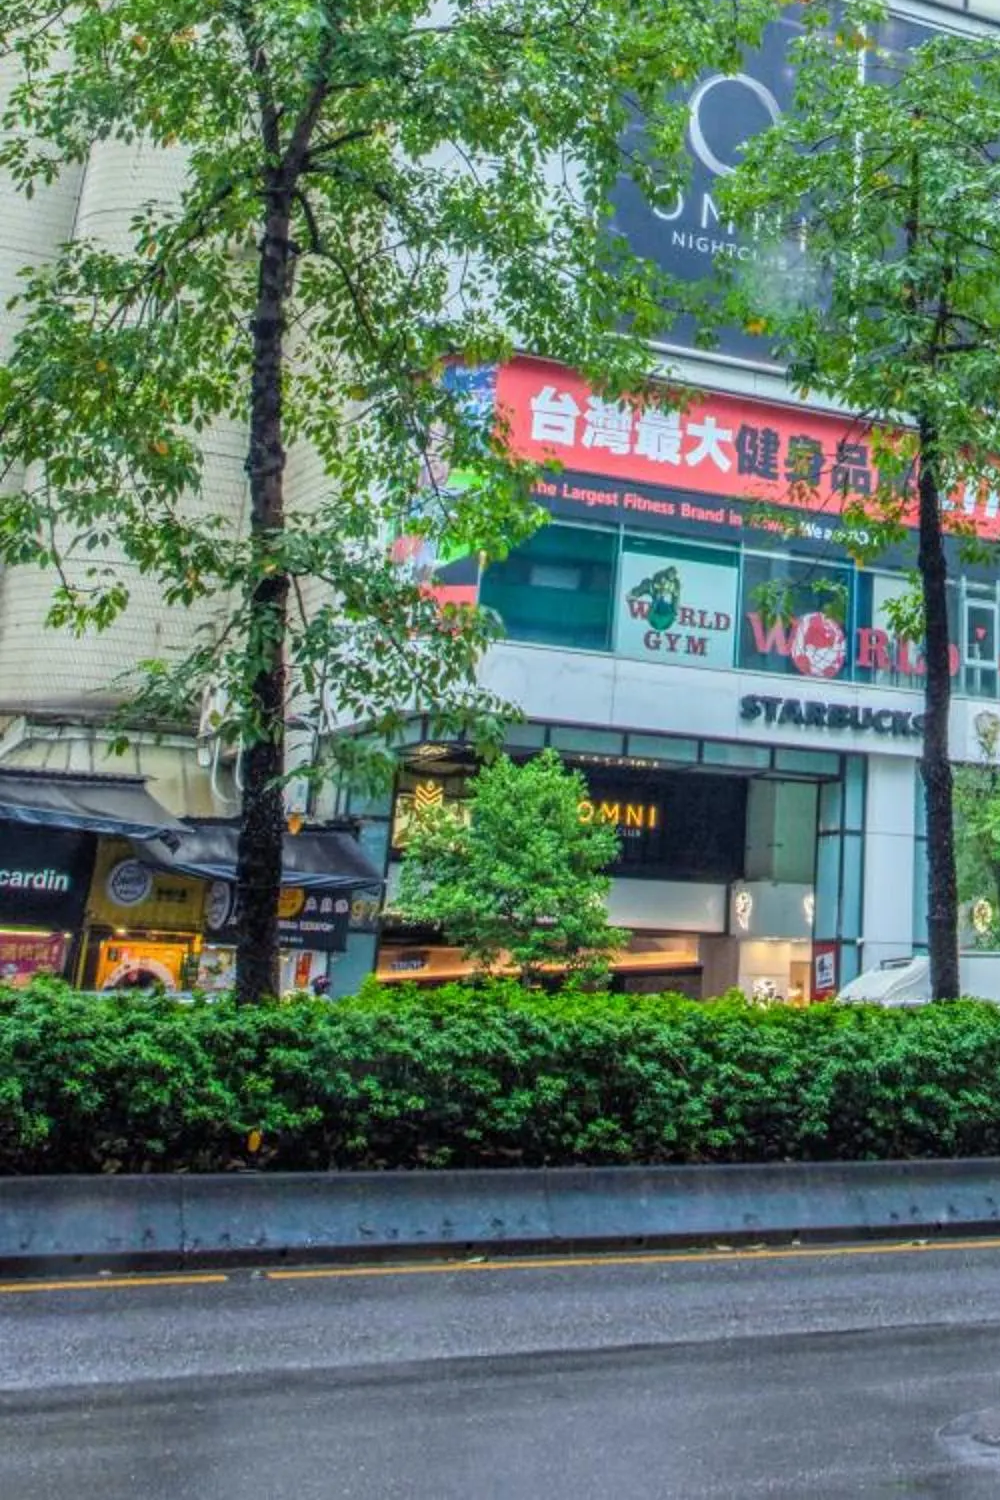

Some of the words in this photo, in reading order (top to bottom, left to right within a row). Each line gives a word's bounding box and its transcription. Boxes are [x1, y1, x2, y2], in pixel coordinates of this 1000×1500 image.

[529, 385, 918, 497] 台灣最大健身品
[562, 482, 619, 507] Largest
[622, 492, 676, 516] Fitness
[680, 501, 725, 524] Brand
[728, 509, 743, 527] in
[643, 630, 710, 656] GYM
[577, 800, 658, 829] OMNI
[0, 867, 70, 892] cardin
